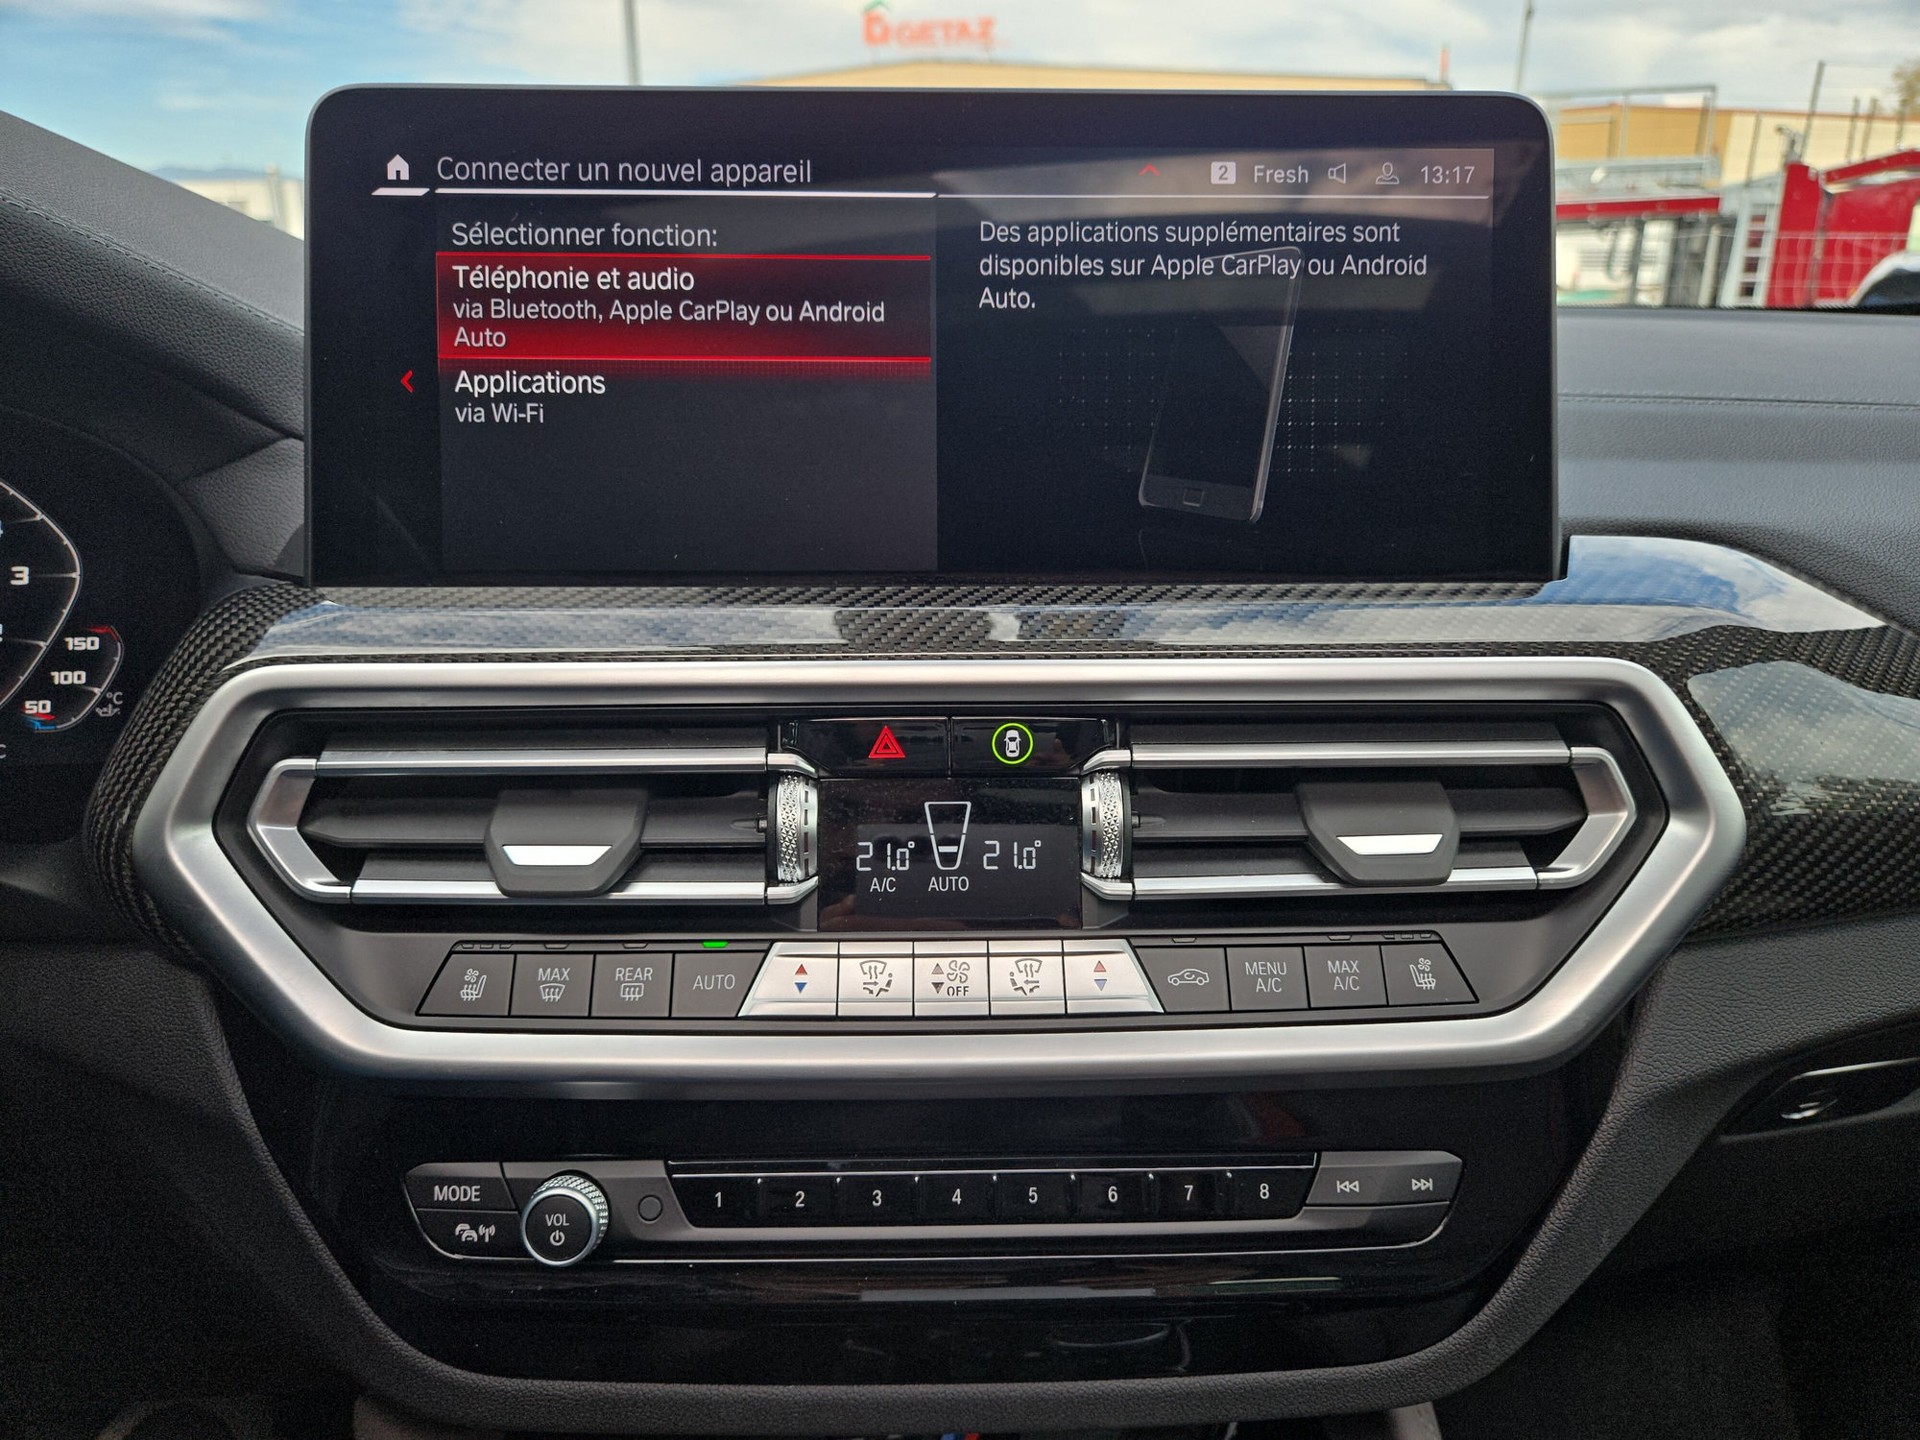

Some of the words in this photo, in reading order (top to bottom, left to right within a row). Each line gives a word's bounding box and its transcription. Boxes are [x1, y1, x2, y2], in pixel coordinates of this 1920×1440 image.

[438, 157, 570, 183] Connecter
[579, 162, 609, 182] un
[619, 159, 701, 182] nouvel
[711, 160, 810, 187] appareil
[1219, 165, 1228, 180] 2
[1254, 165, 1308, 183] Fresh
[1421, 166, 1474, 183] 13:17
[452, 222, 605, 245] Sélectionner
[612, 223, 716, 246] fonction:
[981, 221, 1020, 242] Des
[1028, 222, 1158, 246] applications
[1166, 221, 1346, 248] supplémentaires
[1353, 223, 1400, 242] sont
[980, 254, 1104, 279] disponibles
[1111, 259, 1145, 275] sur
[1151, 255, 1215, 280] Apple
[1220, 255, 1301, 280] CarPlay
[1308, 259, 1334, 275] ou
[1341, 255, 1426, 275] Android
[452, 265, 589, 293] Téléphonie
[597, 268, 620, 289] et
[628, 267, 694, 290] audio
[979, 287, 1035, 308] Auto.
[453, 299, 483, 318] via
[491, 299, 602, 323] Bluetooth,
[610, 300, 672, 324] Apple
[678, 300, 760, 325] CarPlay
[766, 305, 792, 321] ou
[800, 301, 884, 322] Android
[454, 327, 505, 347] Auto
[455, 370, 605, 397] Applications
[455, 403, 485, 422] via
[492, 403, 543, 423] Wi-Fi
[11, 566, 29, 585] 3
[65, 637, 99, 650] 150
[51, 671, 86, 684] 100
[25, 700, 51, 714] 50
[870, 877, 895, 892] A/C
[928, 876, 969, 891] AUTO
[538, 968, 570, 981] MAX
[616, 968, 653, 981] REAR
[1245, 962, 1286, 975] MENU
[1328, 961, 1359, 973] MAX
[693, 974, 735, 990] AUTO
[1256, 978, 1281, 992] A/C
[1334, 976, 1359, 990] A/C
[947, 986, 969, 996] OFF
[434, 1185, 480, 1201] MODE
[714, 1192, 723, 1208] 1
[795, 1191, 805, 1208] 2
[872, 1190, 882, 1207] 3
[951, 1189, 962, 1205] 4
[1028, 1187, 1038, 1204] 5
[1108, 1186, 1118, 1203] 6
[1184, 1185, 1194, 1201] 7
[1259, 1183, 1270, 1200] 8
[546, 1214, 569, 1226] VOL
